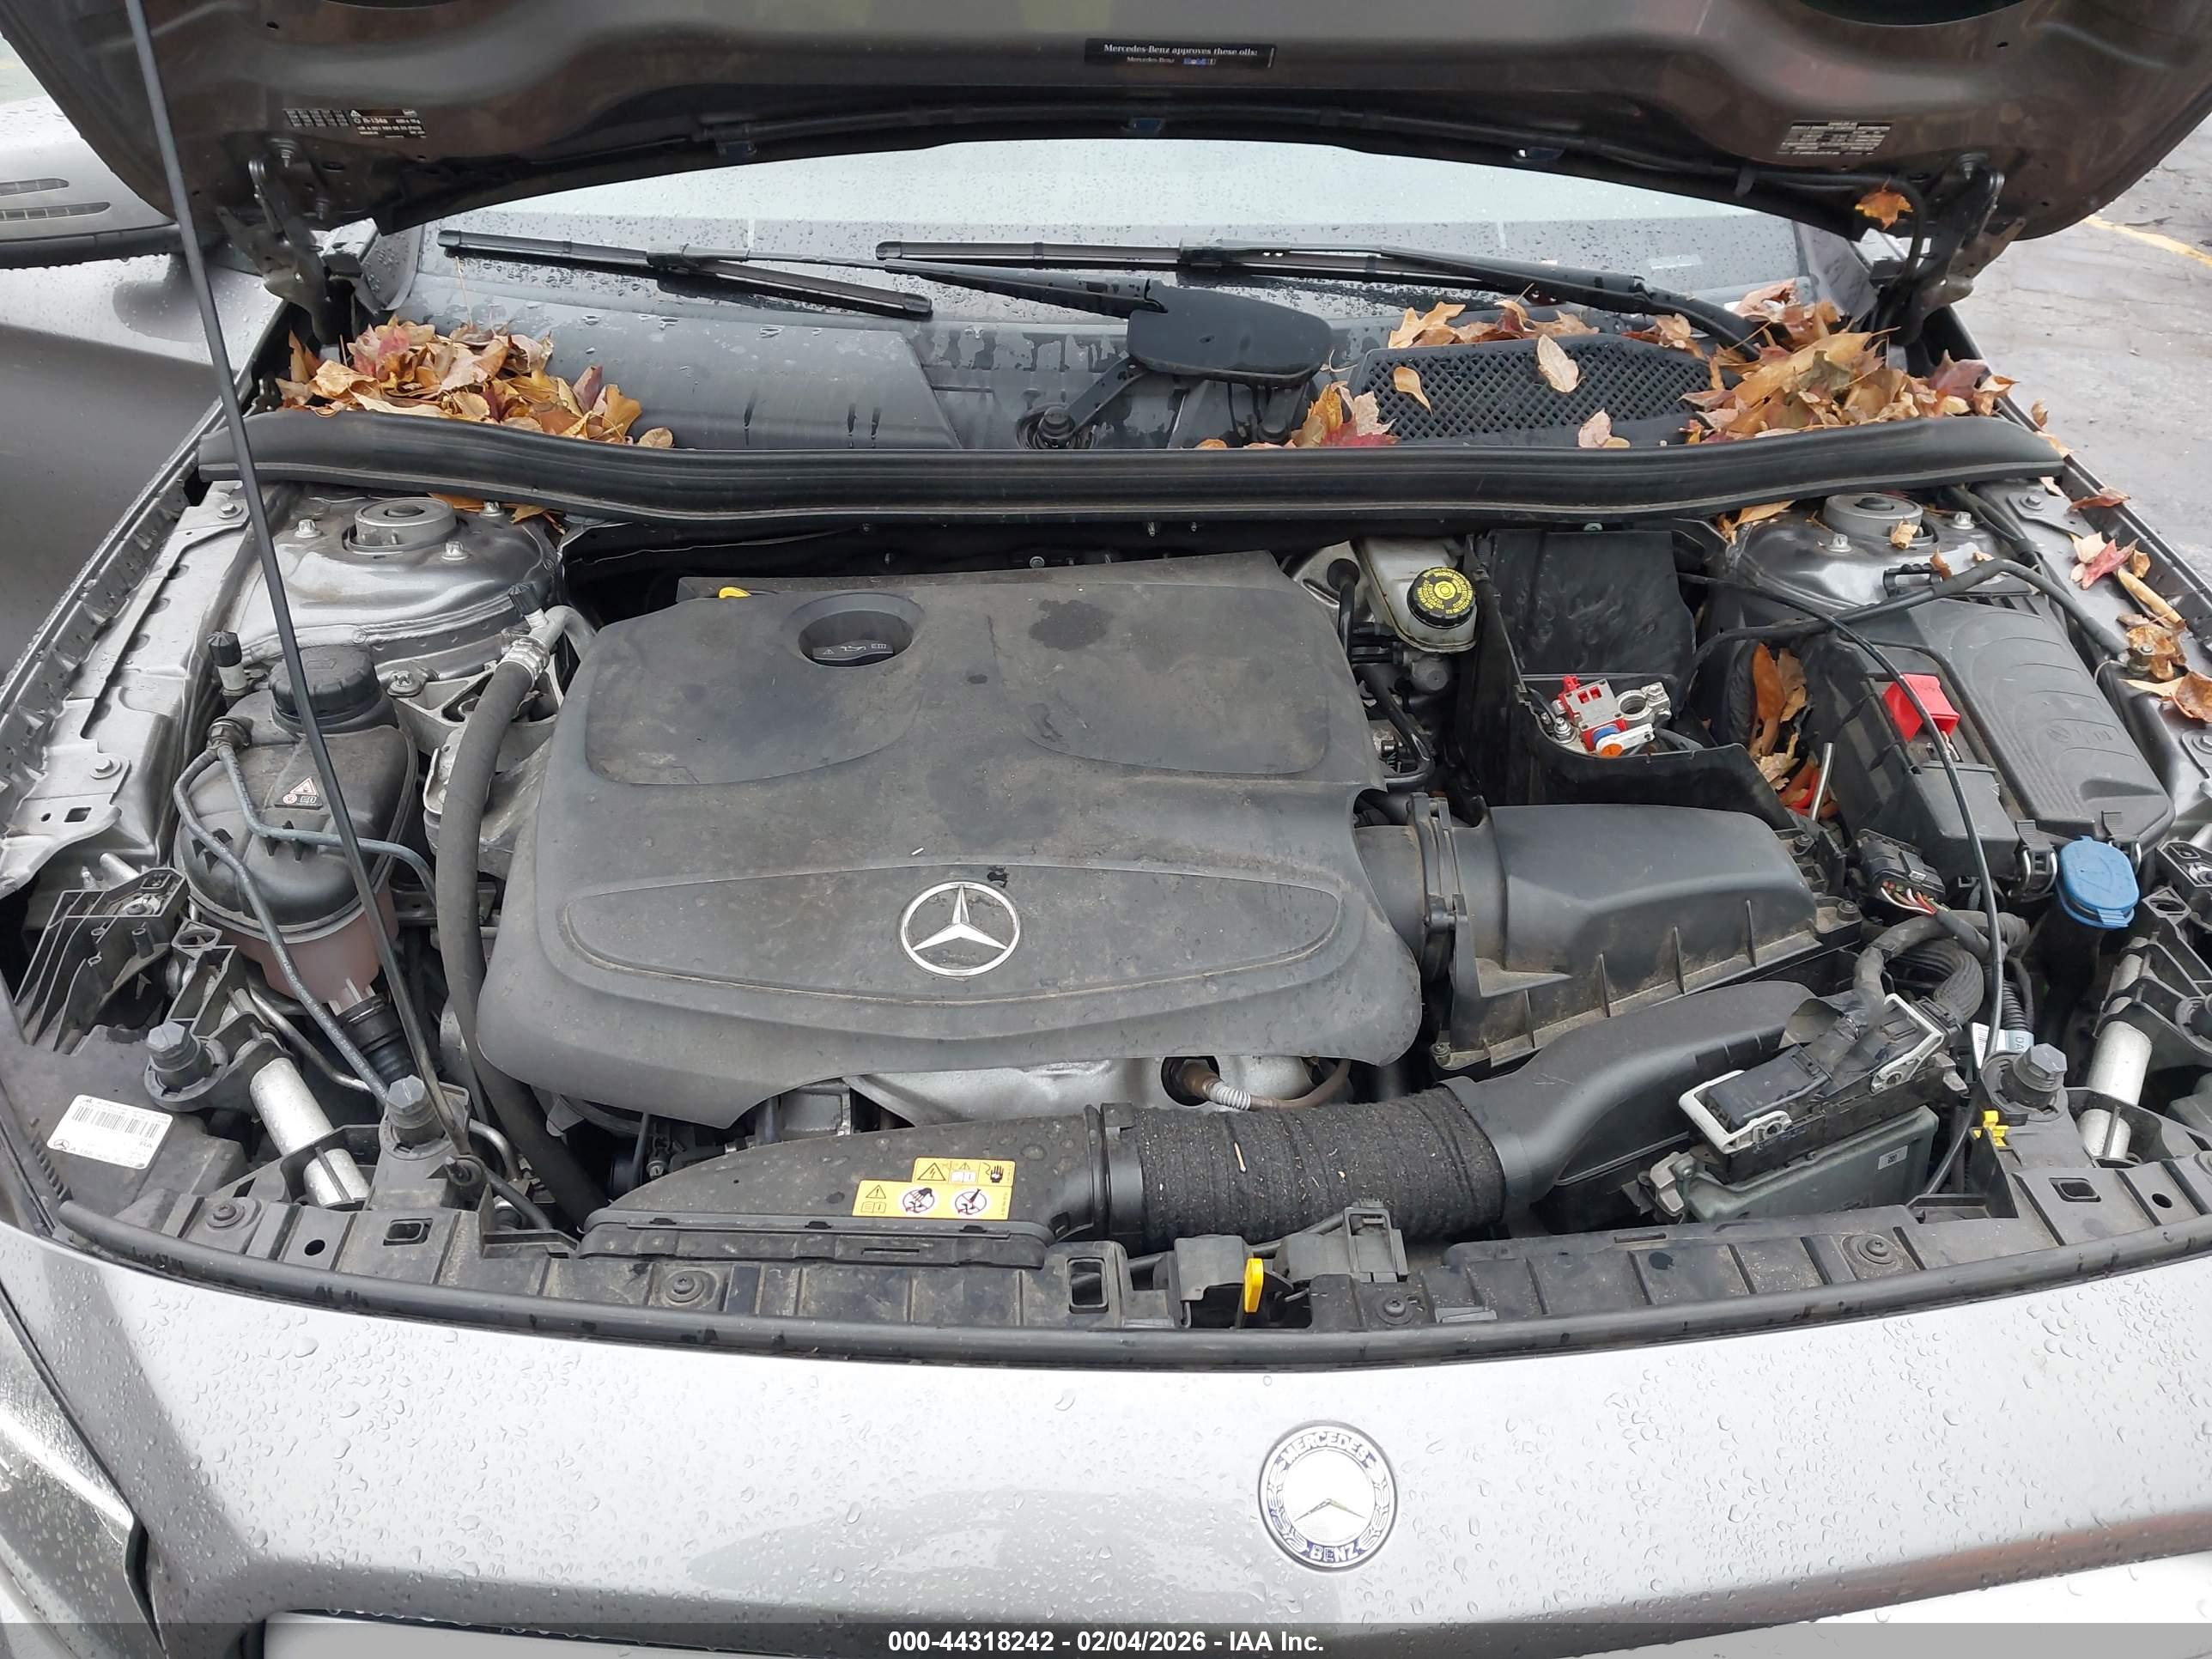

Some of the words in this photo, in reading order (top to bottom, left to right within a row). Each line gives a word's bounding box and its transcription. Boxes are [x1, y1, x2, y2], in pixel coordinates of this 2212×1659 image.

[1103, 44, 1170, 54] Mercedes-Benz
[1171, 46, 1212, 56] approves
[1213, 47, 1237, 56] these
[1279, 1431, 1370, 1465] MERCEDES
[1310, 1543, 1359, 1563] BENZ
